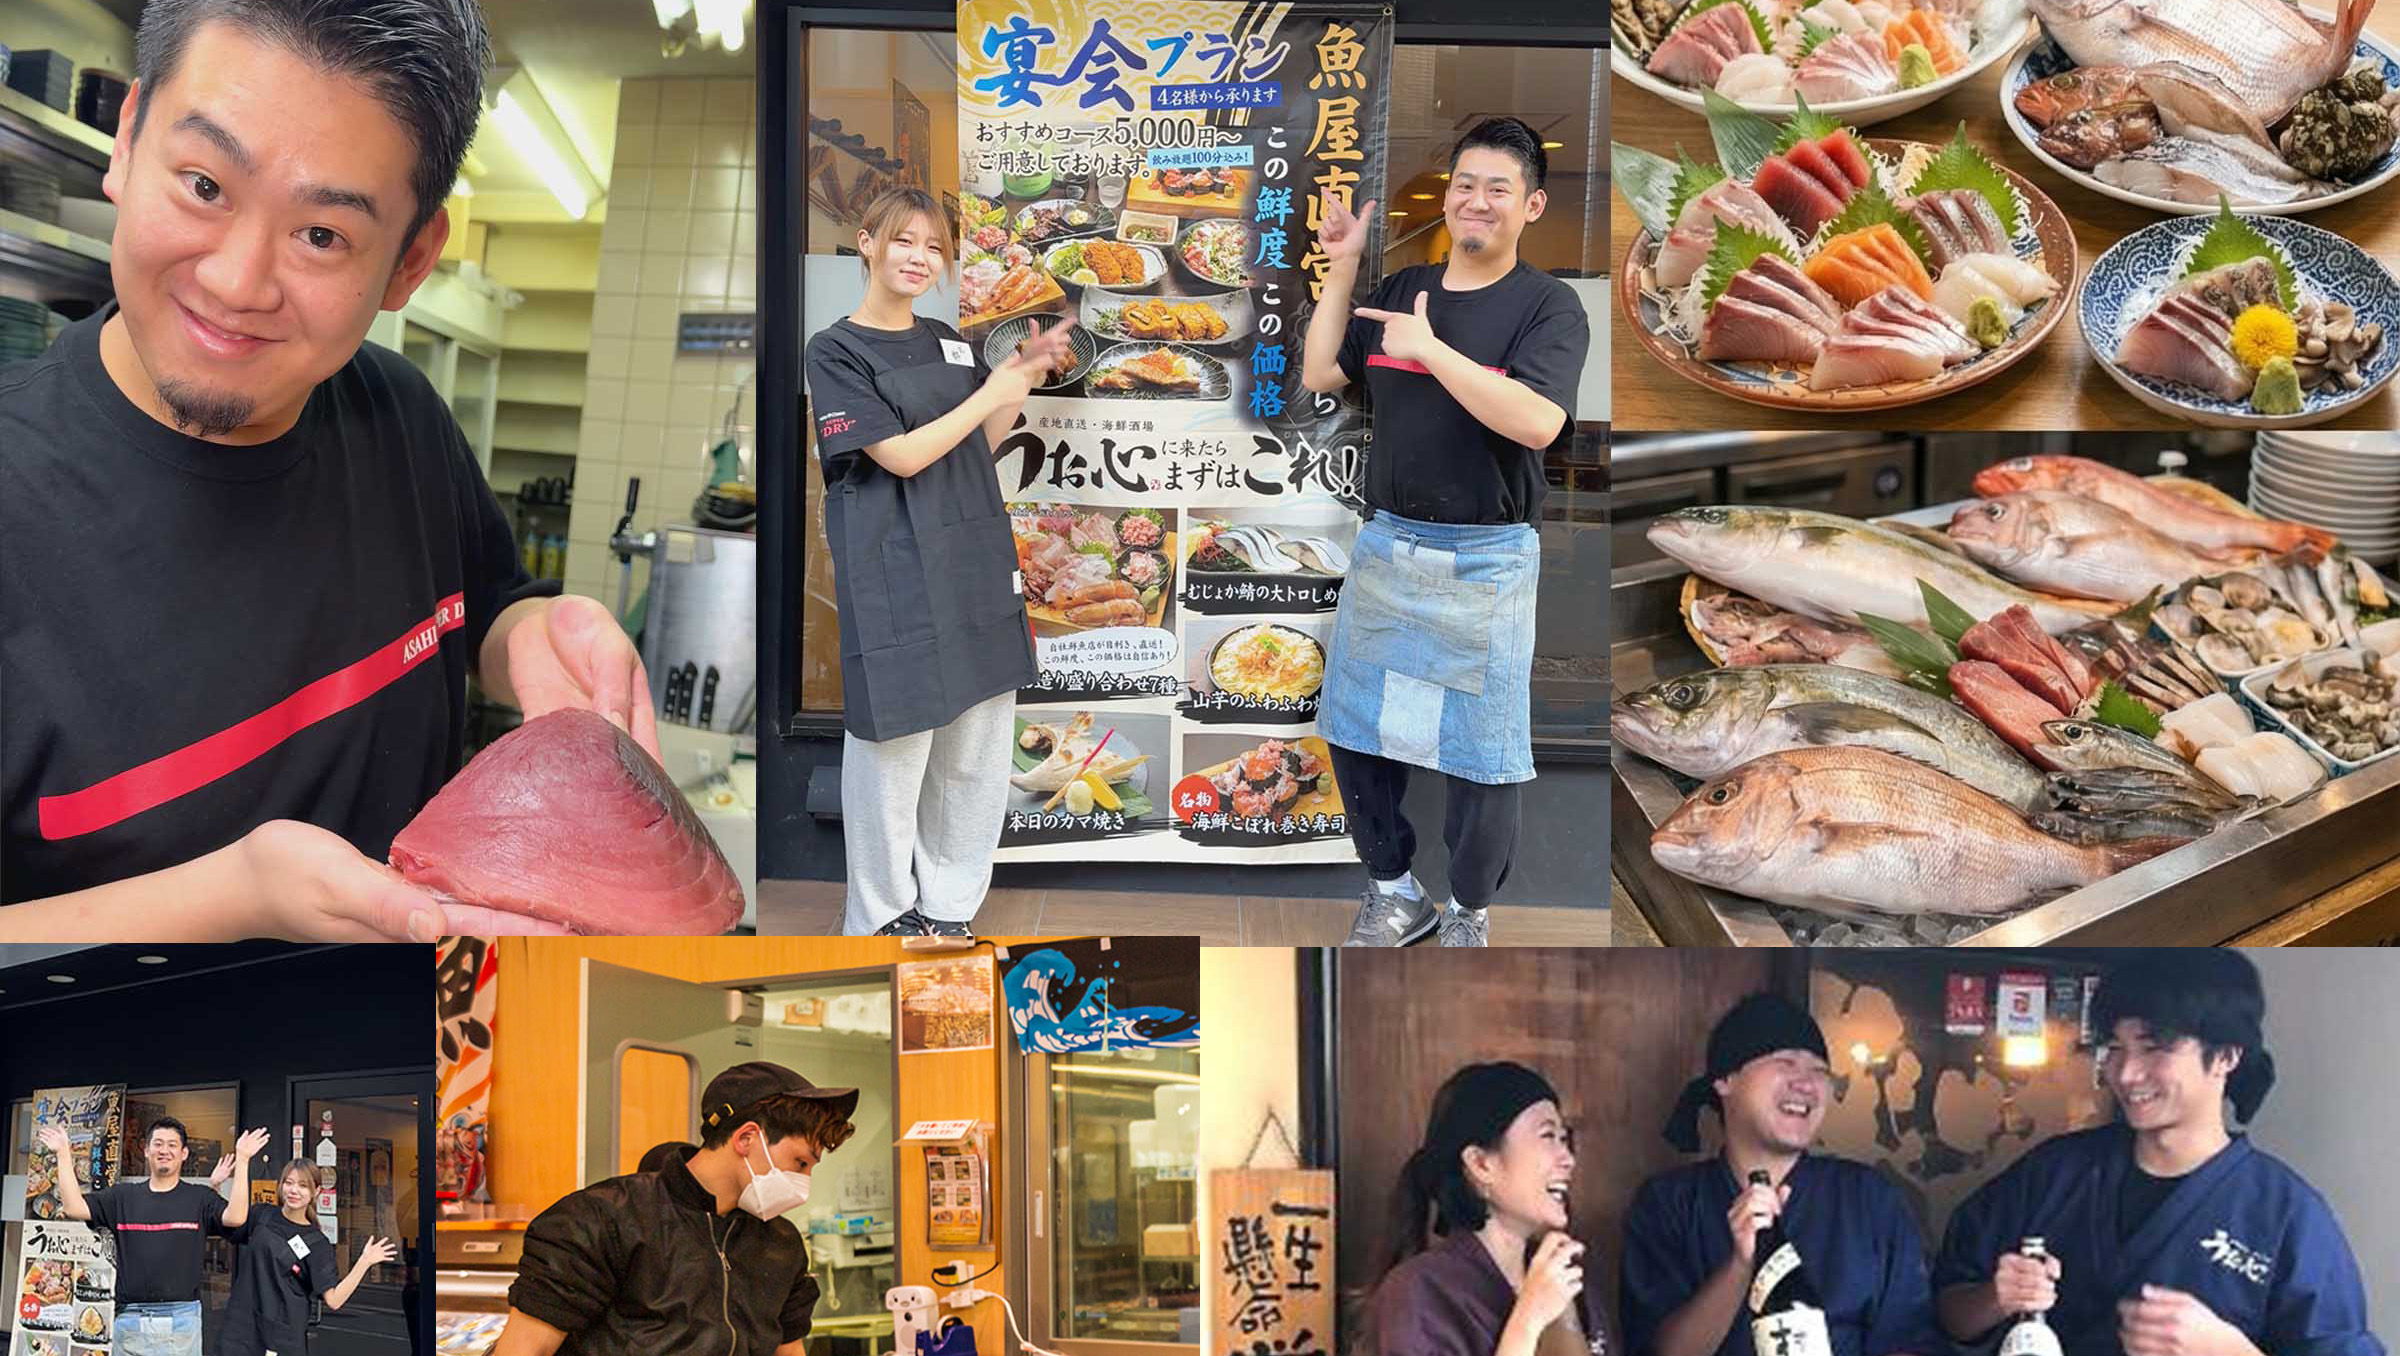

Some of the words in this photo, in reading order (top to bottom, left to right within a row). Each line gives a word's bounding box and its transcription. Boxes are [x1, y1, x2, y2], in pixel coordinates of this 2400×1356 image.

[974, 16, 1291, 112] 宴会プラン
[1157, 87, 1277, 107] 4名様から承ります
[978, 150, 1151, 179] ご用意しております。
[1254, 126, 1295, 270] この鮮度
[1248, 283, 1288, 418] この価格
[1038, 416, 1154, 432] 産地直送・海鮮酒場
[1161, 439, 1228, 457] に来たら
[1165, 461, 1240, 491] まずは
[1187, 583, 1341, 603] むじょか鯖の大トロしめ
[403, 625, 438, 664] ASAHI
[1021, 670, 1177, 695] 造り盛り合わせ7種
[1179, 793, 1212, 808] 名物
[1008, 812, 1126, 831] 本日のカマ焼き
[1190, 812, 1347, 834] 海鮮こぼれ巻き寿司
